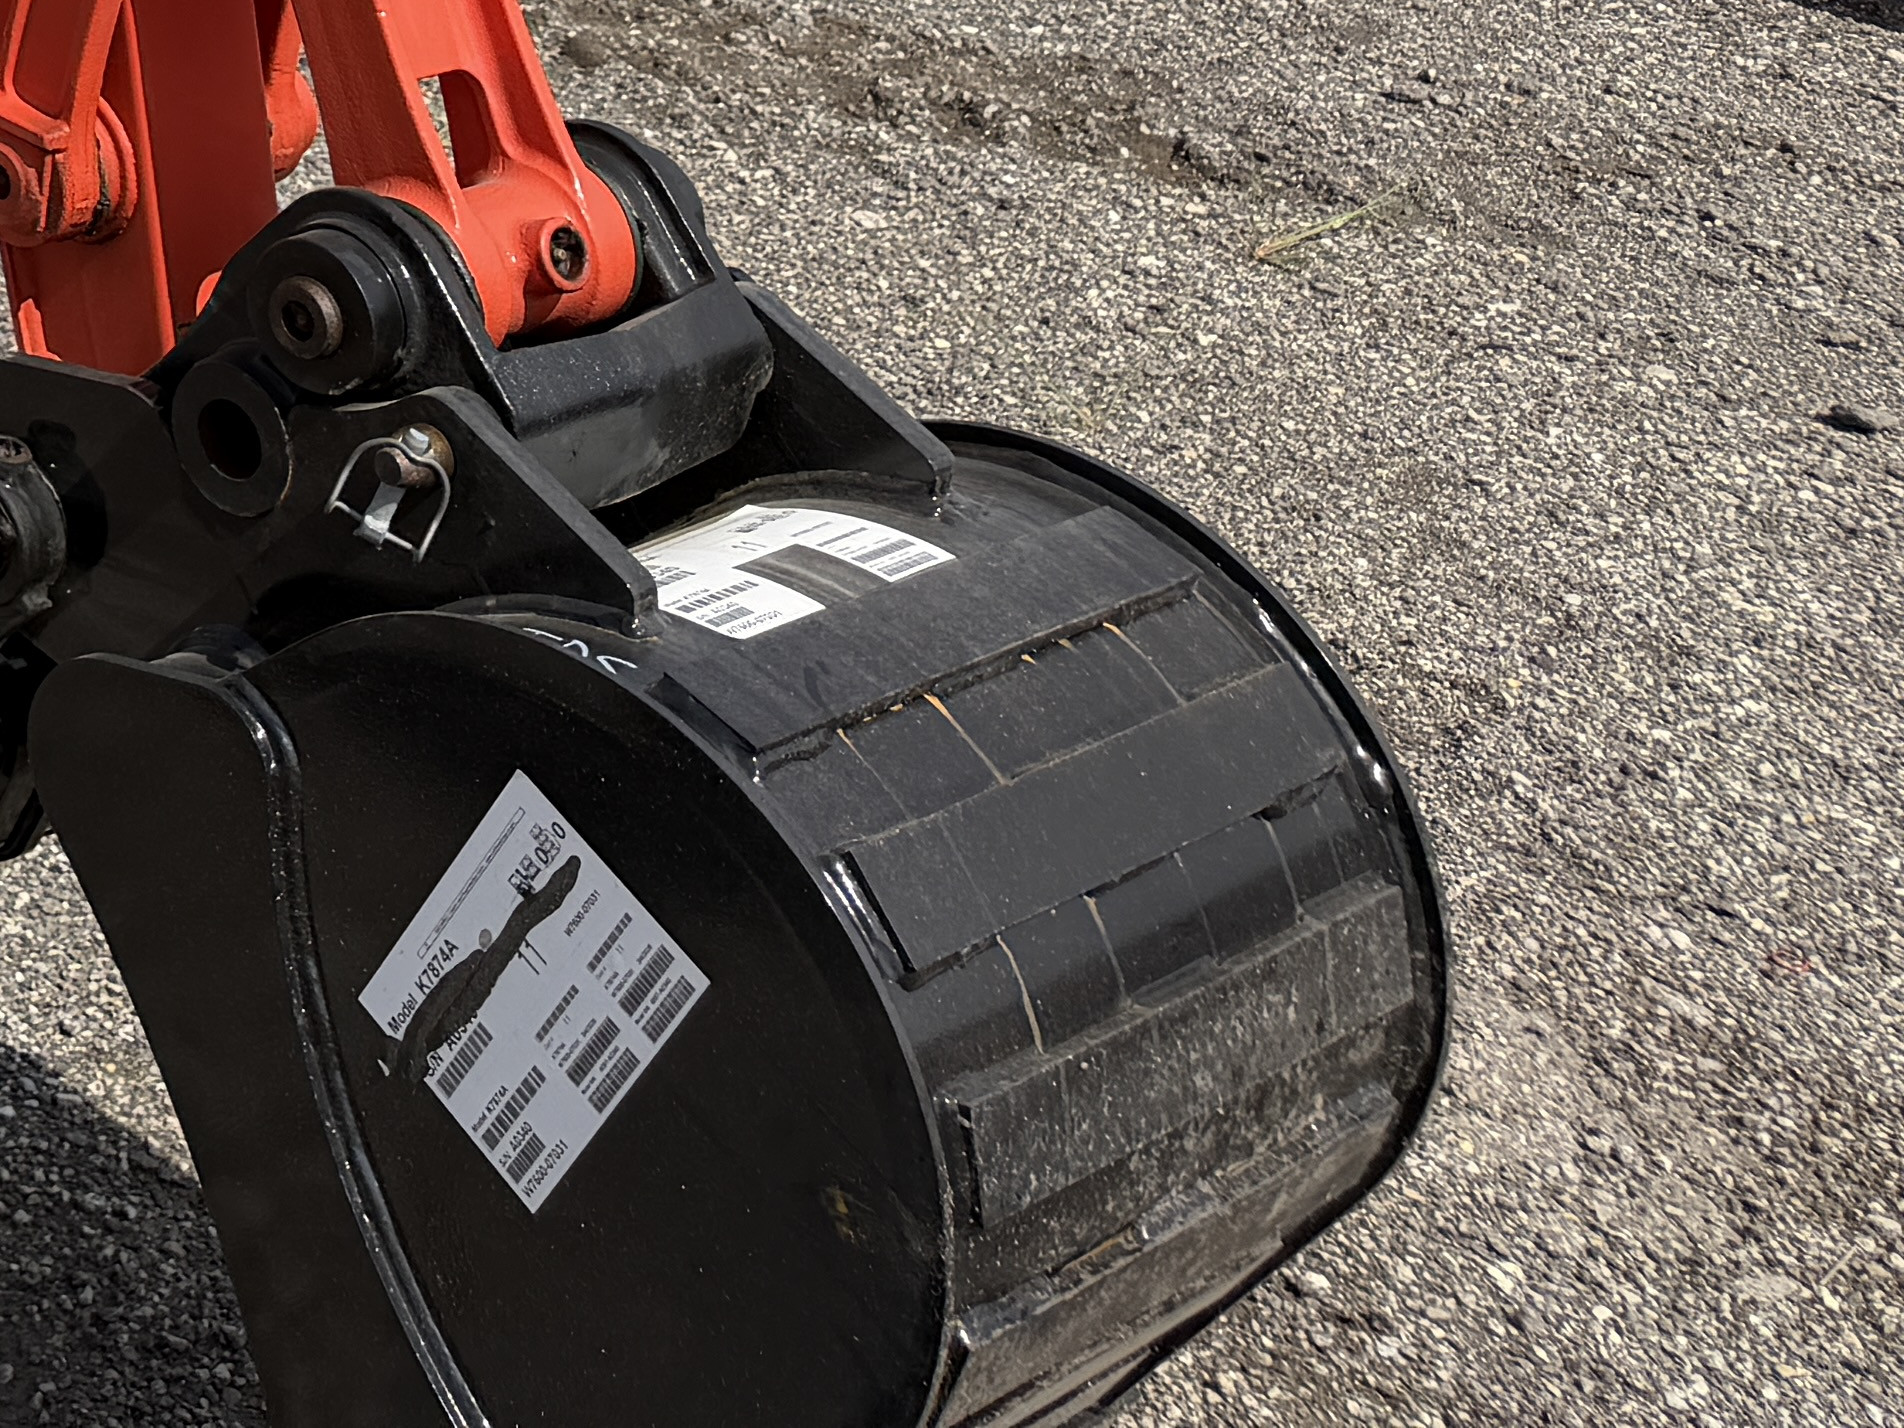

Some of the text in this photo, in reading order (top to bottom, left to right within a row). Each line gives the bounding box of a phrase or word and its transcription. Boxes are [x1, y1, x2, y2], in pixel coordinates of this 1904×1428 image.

[387, 934, 459, 1035] Model K7874A
[521, 1137, 569, 1199] W7600-07031
